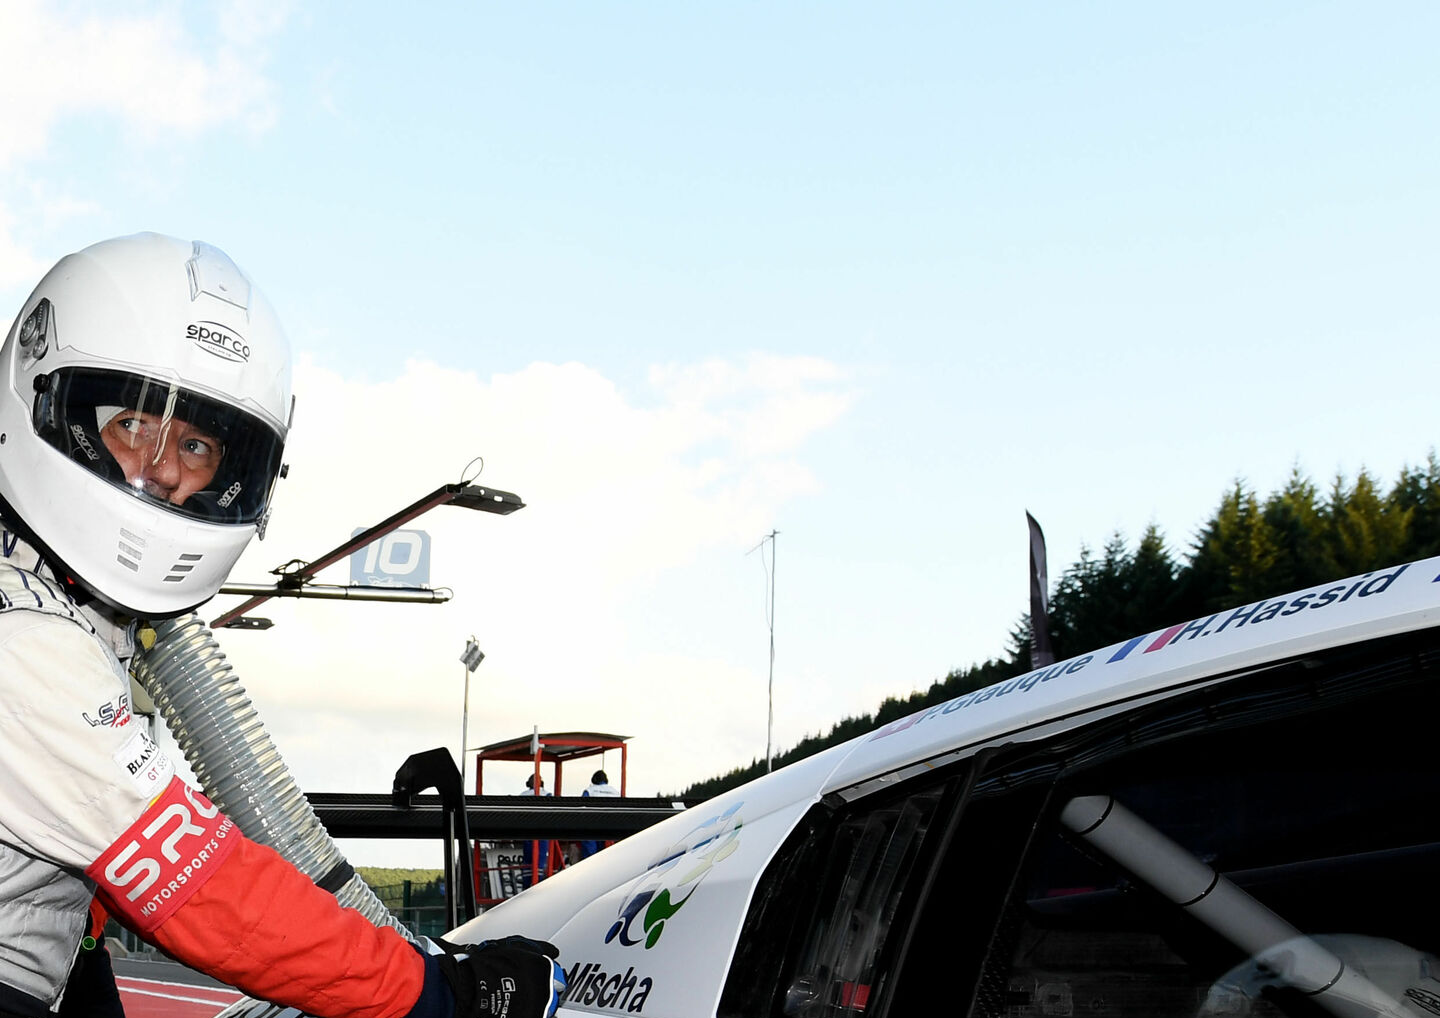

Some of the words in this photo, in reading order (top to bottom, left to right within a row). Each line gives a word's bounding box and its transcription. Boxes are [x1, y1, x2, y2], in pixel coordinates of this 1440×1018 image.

[186, 324, 250, 358] sparco
[70, 424, 99, 460] sparco
[363, 532, 422, 575] 10
[1168, 564, 1410, 645] H.Hassid
[141, 837, 219, 918] MOTORSPORTS
[561, 962, 654, 1013] Mischa
